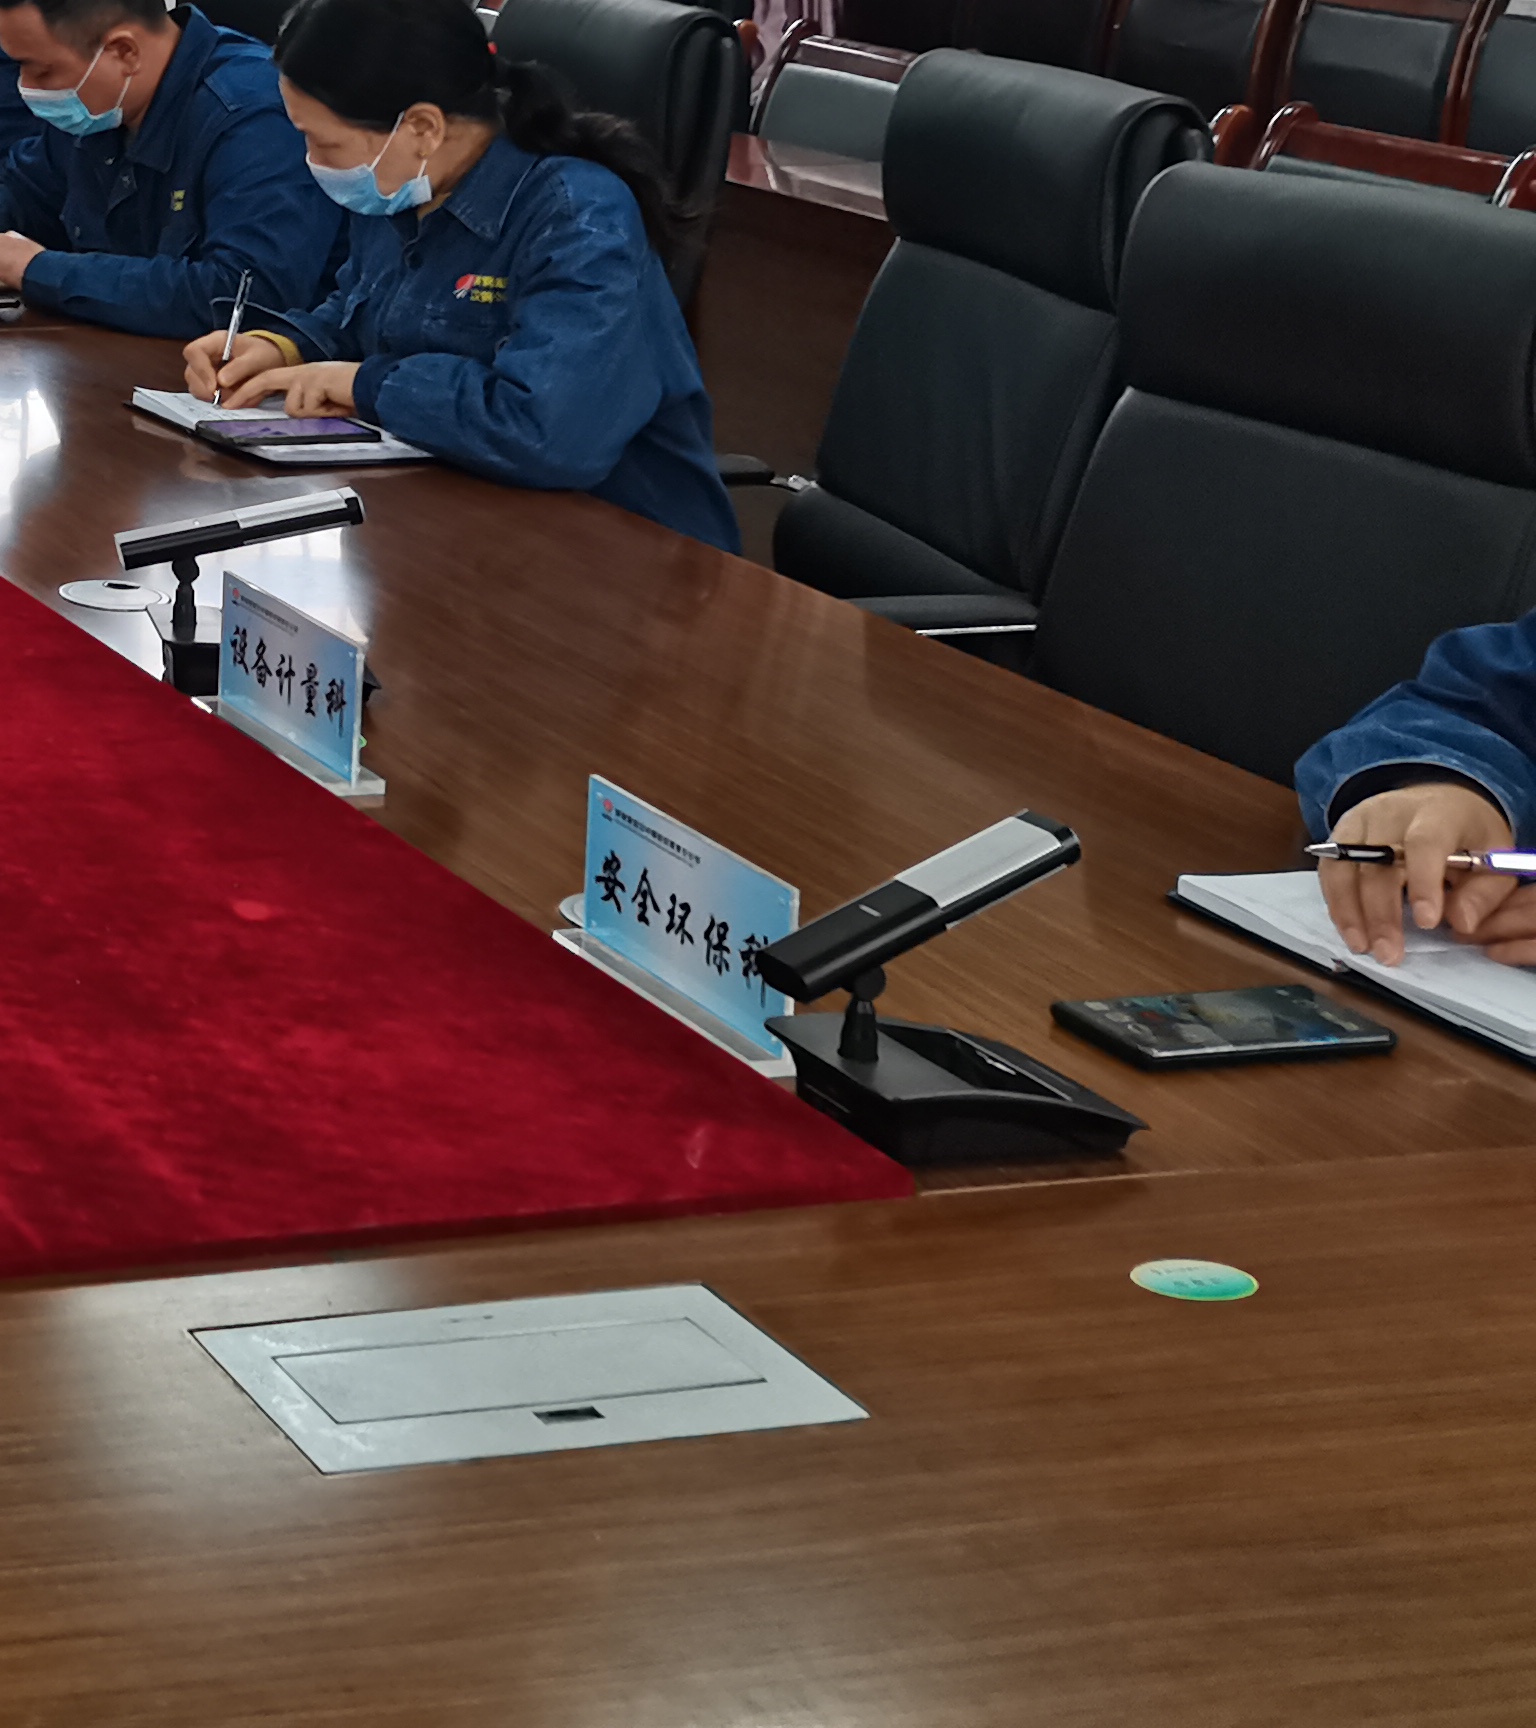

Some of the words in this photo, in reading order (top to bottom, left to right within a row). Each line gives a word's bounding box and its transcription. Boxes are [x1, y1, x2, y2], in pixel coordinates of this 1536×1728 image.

[229, 624, 347, 738] 设备计量科
[594, 849, 771, 1009] 安全环保科
